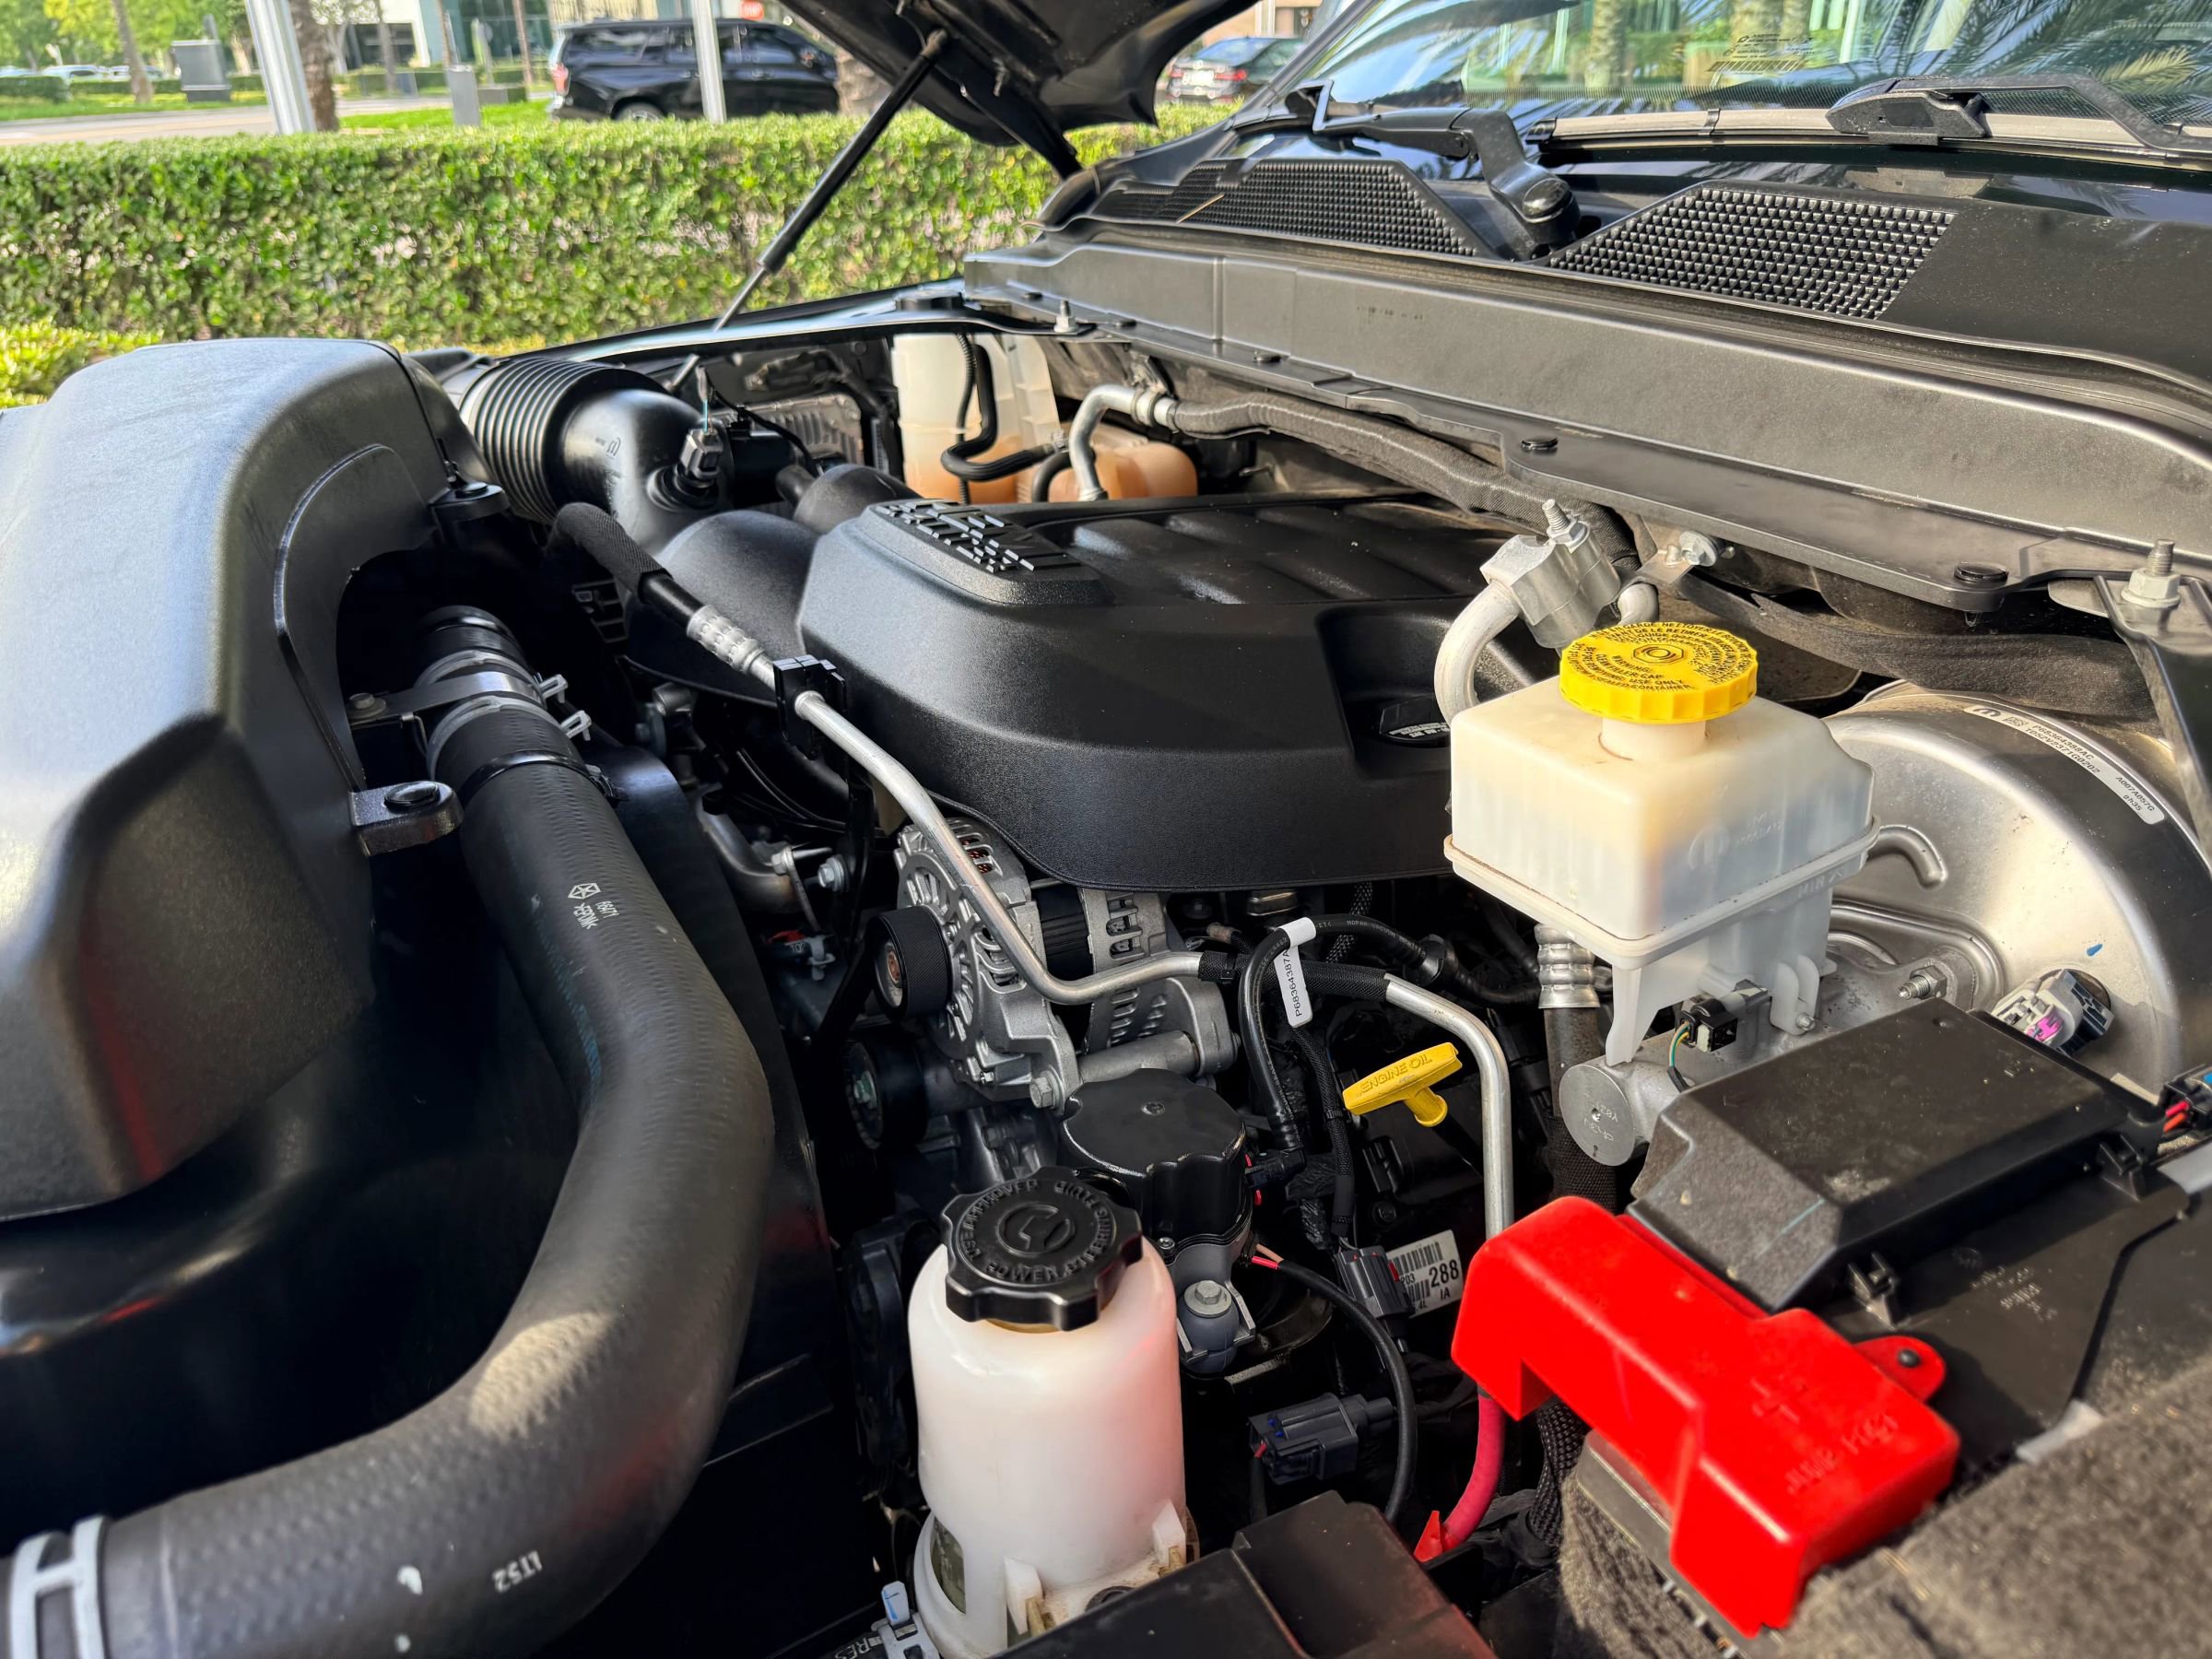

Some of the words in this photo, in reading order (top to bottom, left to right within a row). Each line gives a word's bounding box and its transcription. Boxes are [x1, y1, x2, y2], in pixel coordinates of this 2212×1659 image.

[1359, 1062, 1409, 1093] ENGINE
[1408, 1053, 1433, 1069] OIL
[1053, 1180, 1098, 1210] FLUID
[1429, 1259, 1460, 1288] 288
